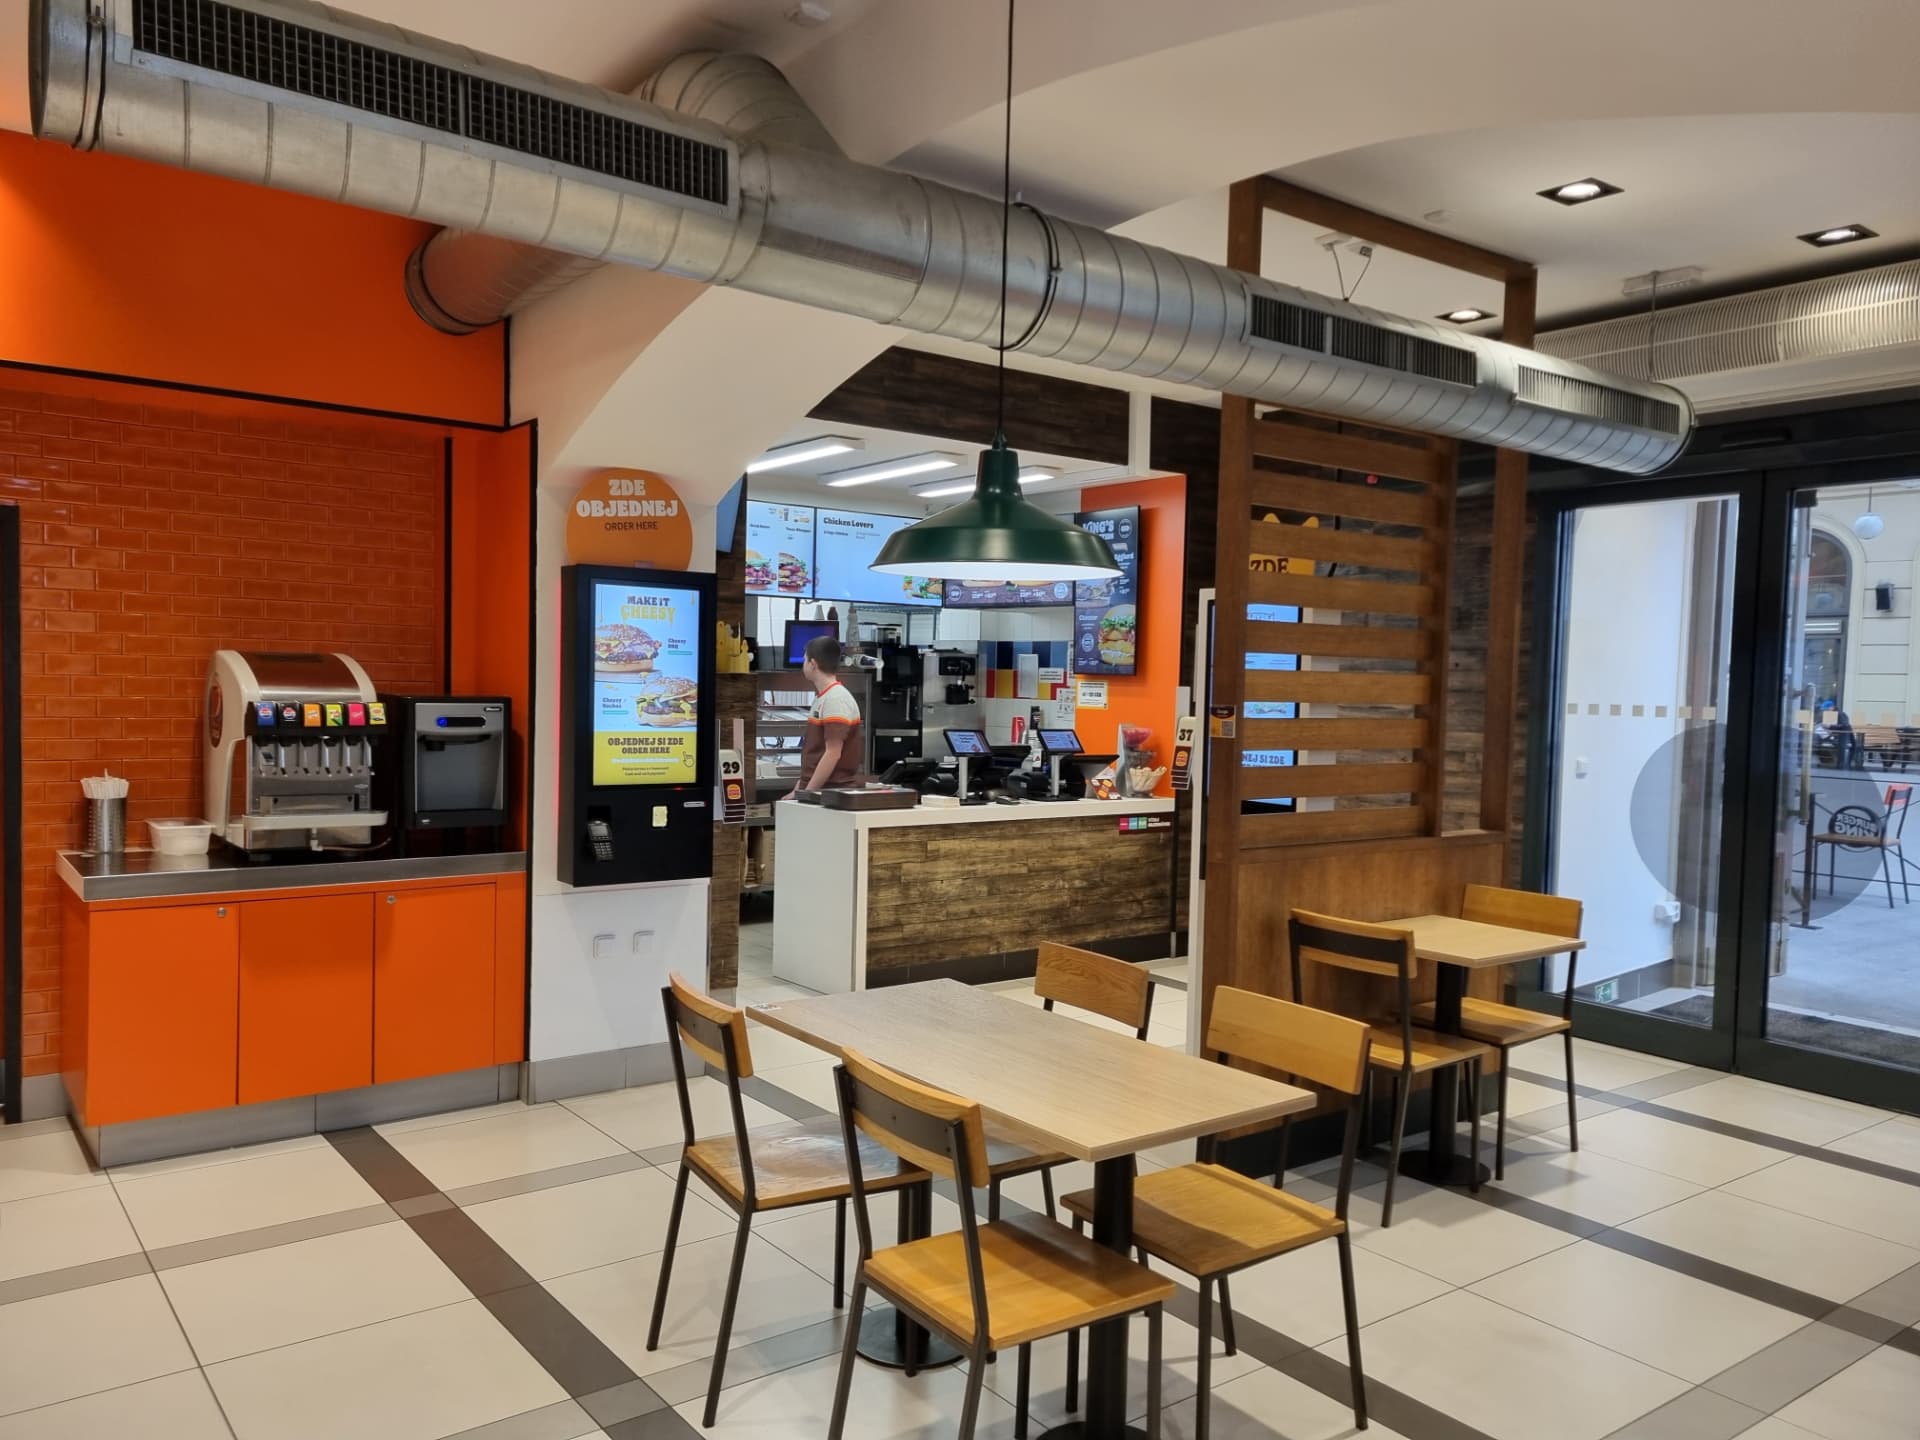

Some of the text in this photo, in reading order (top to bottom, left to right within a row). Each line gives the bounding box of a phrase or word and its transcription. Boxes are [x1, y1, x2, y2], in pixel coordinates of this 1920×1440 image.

[608, 479, 646, 496] ZDE
[576, 500, 679, 518] OBJEDNEJ
[605, 521, 658, 531] ORDER HERE
[823, 517, 874, 529] Chicken Lovers
[627, 595, 658, 607] MAKE
[621, 605, 676, 623] CHEESY
[1179, 729, 1193, 741] 37
[608, 737, 656, 746] OBJEDNEJ
[667, 737, 684, 746] ZDE
[1269, 755, 1285, 765] ZDE
[722, 761, 740, 774] 29
